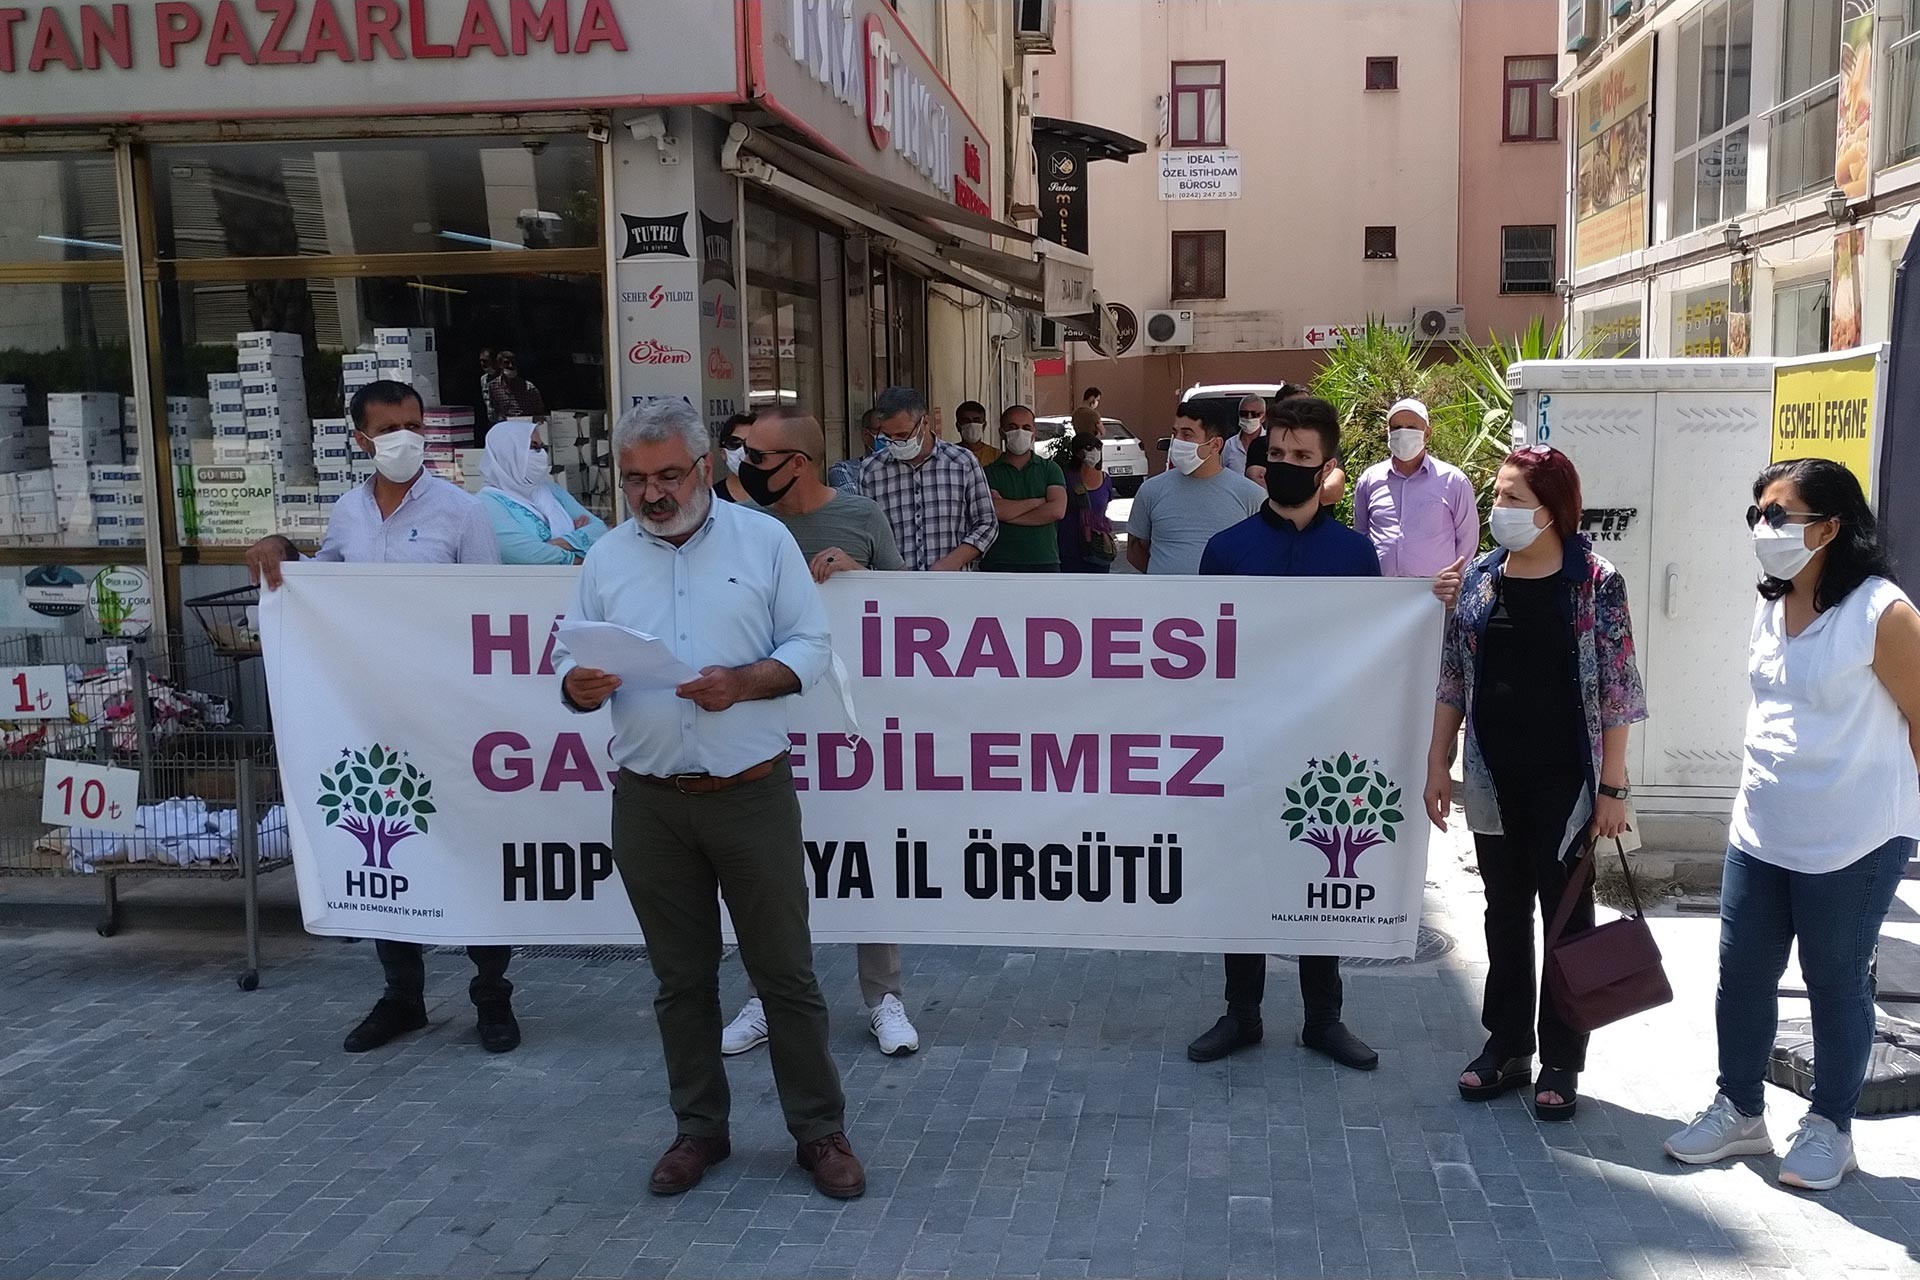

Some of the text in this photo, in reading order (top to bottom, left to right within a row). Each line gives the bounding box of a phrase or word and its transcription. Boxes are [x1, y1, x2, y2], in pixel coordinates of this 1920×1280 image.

[155, 0, 629, 68] PAZARLAMA
[1187, 152, 1215, 164] İDEAL
[1162, 165, 1238, 177] ÖZEL İSTİHDAM
[1048, 182, 1079, 192] Salon
[1179, 179, 1221, 189] BÜROSU
[631, 225, 679, 243] TUTKU
[622, 291, 694, 302] SEHER YILDIZI
[629, 340, 691, 365] Özlem
[710, 399, 735, 417] ERKA
[1780, 392, 1868, 450] ÇEŞMELİ EFSANE
[231, 488, 272, 501] ÇORAP
[862, 600, 1237, 679] İRADESİ
[503, 842, 613, 901] HDP
[896, 828, 942, 899] İL
[964, 829, 1183, 905] ÖRGÜTÜ
[346, 870, 409, 901] HDP
[1308, 882, 1376, 910] HDP
[327, 902, 444, 918] KLARIN DEMOKRATİK PARTİSİ
[1271, 913, 1408, 925] HALKLARIN DEMOKRATİK PARTİSİ
